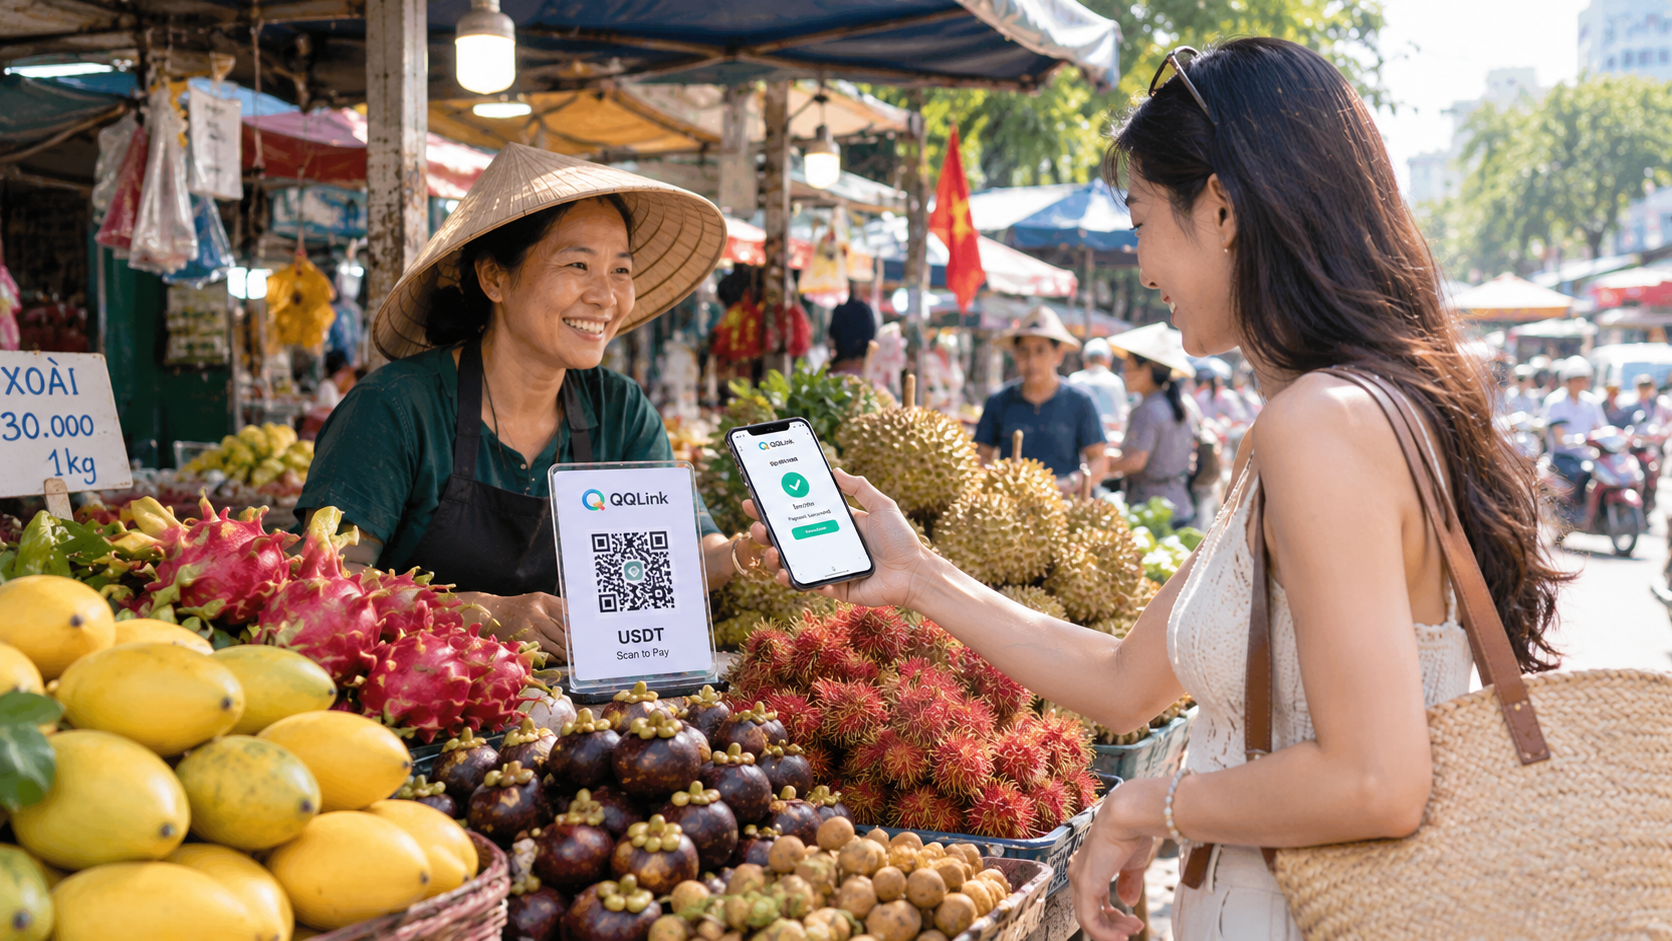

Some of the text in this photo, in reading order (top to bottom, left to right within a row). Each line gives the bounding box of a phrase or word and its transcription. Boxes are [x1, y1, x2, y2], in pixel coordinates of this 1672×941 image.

[1, 356, 79, 396] XOÀI
[1, 411, 94, 442] 30.000
[47, 447, 97, 485] 1kg
[610, 491, 669, 507] QQLink
[617, 627, 665, 644] USDT
[616, 647, 669, 661] Scan to Pay
